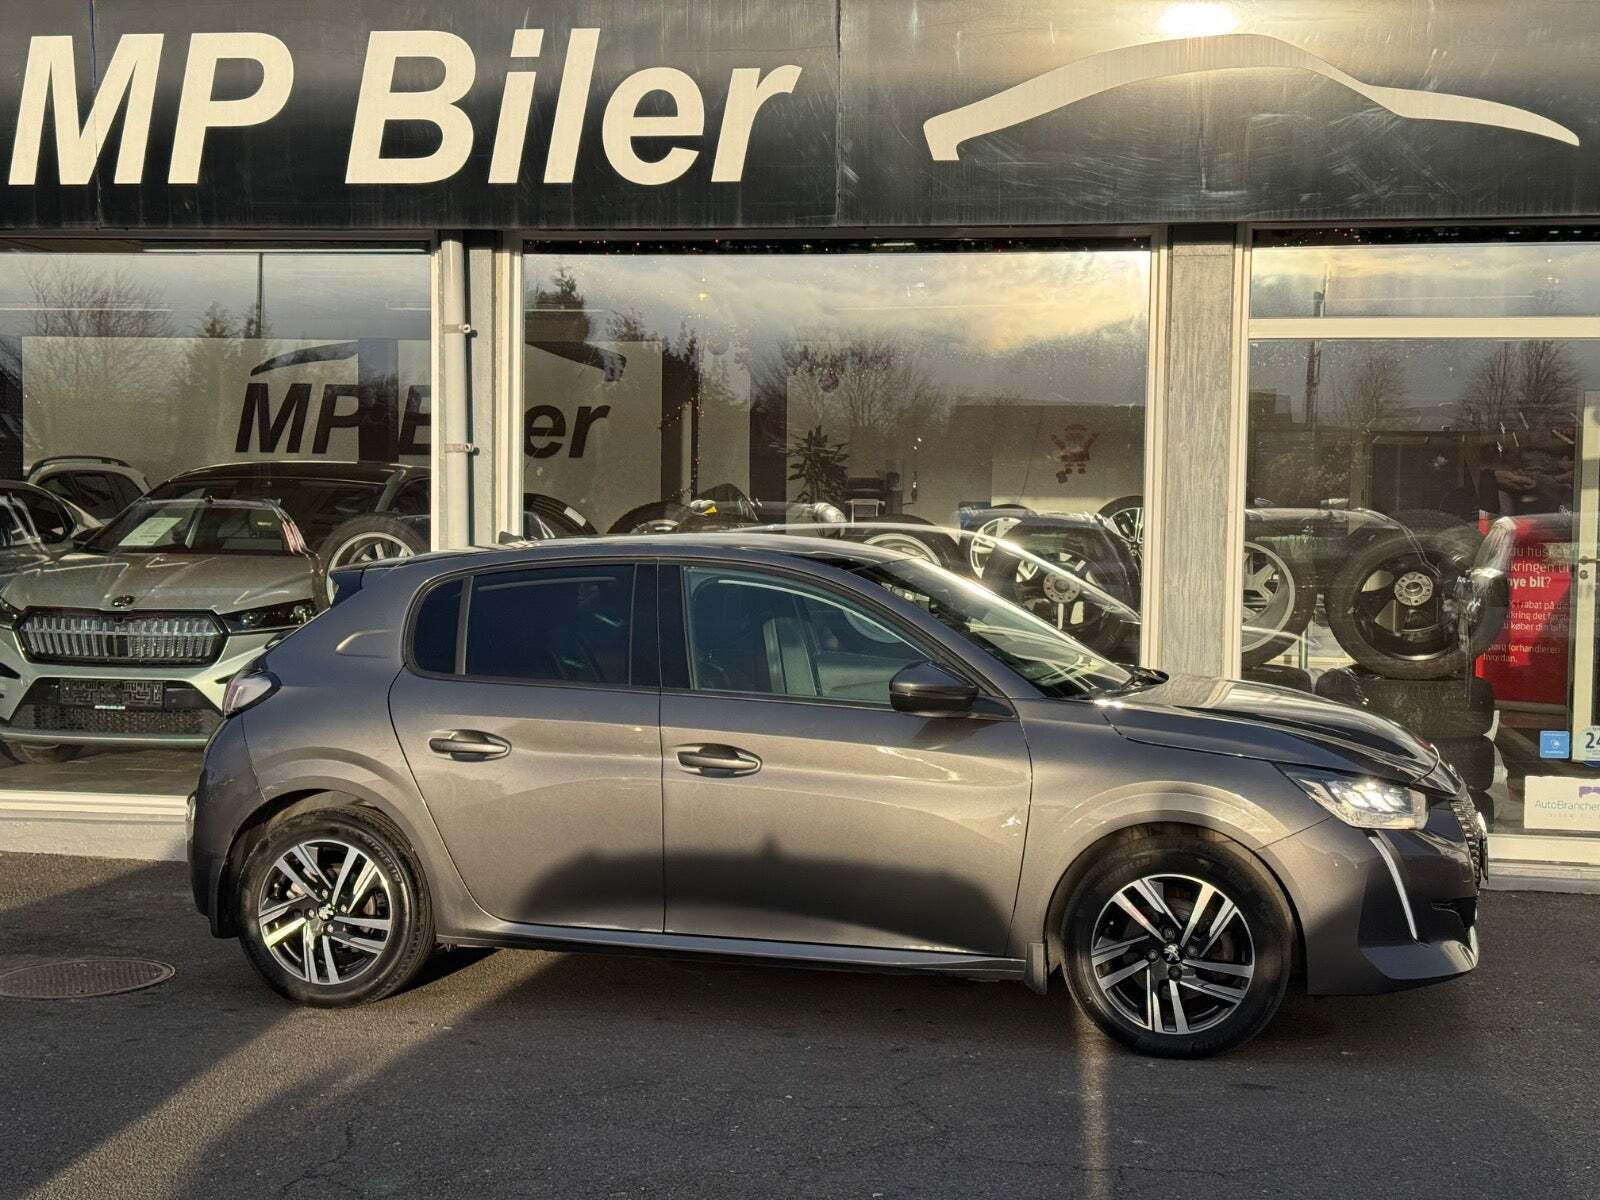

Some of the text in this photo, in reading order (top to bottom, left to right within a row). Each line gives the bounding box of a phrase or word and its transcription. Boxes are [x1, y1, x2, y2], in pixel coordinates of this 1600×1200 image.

[8, 27, 803, 188] MP Biler
[235, 383, 360, 454] MP
[1529, 575, 1552, 589] bil?
[1510, 621, 1534, 632] køber
